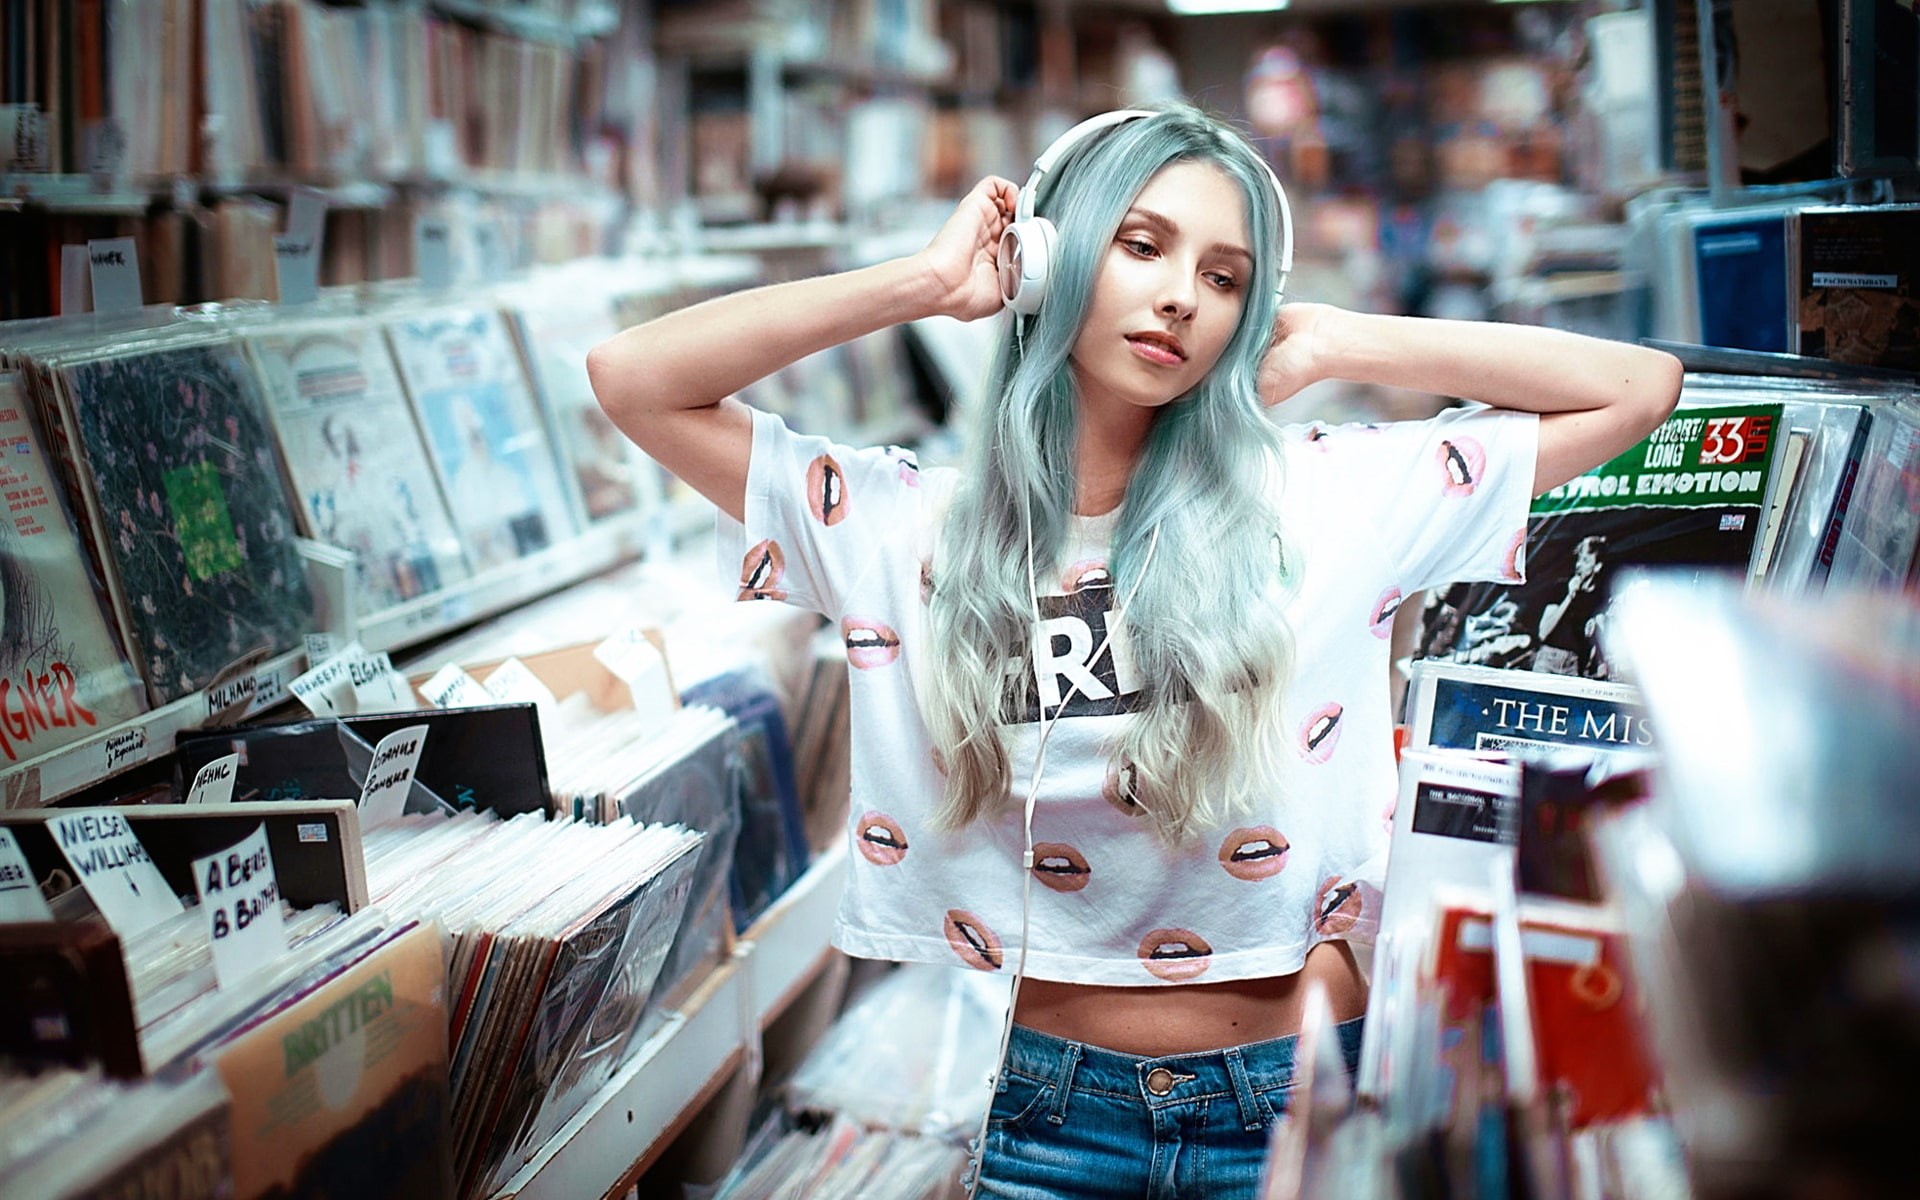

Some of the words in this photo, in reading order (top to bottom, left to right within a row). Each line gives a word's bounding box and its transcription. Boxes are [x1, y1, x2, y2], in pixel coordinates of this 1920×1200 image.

[1644, 443, 1684, 468] LONG
[1700, 417, 1746, 464] 33
[1537, 473, 1631, 500] ETROL
[1636, 471, 1762, 495] EMOTION
[350, 657, 387, 687] ELGAR
[0, 661, 97, 761] GNER
[1492, 698, 1570, 736] THE
[213, 907, 230, 940] B
[283, 968, 394, 1079] BRITTEN
